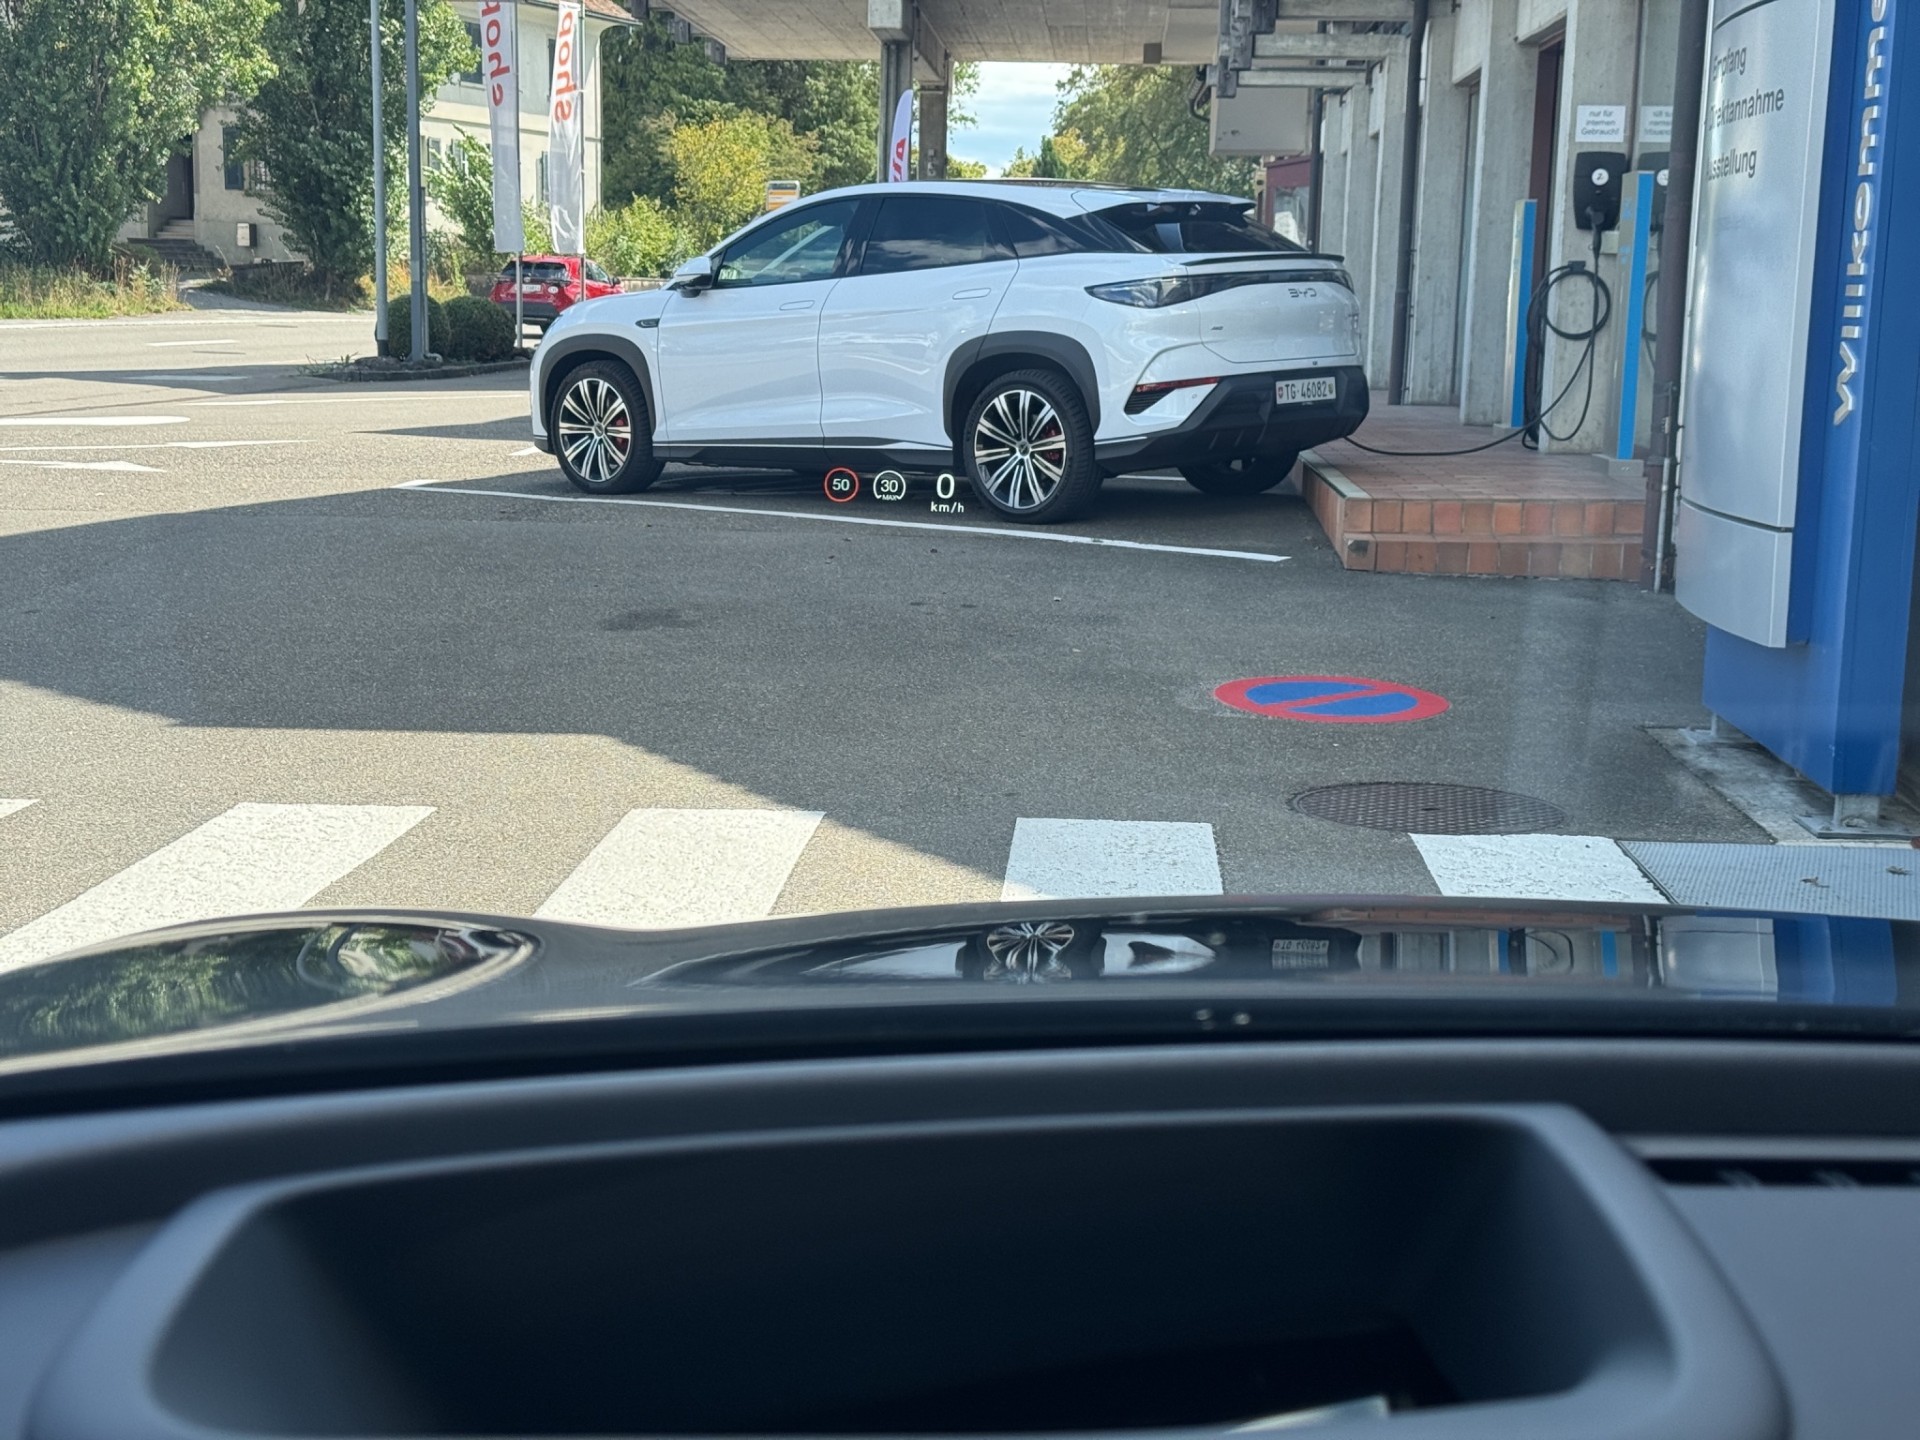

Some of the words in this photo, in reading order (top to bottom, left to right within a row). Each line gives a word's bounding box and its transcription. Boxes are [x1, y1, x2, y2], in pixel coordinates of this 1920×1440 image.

[1708, 88, 1785, 132] Dektannahme
[1706, 148, 1758, 181] sstellung
[1288, 287, 1317, 298] BYD
[832, 478, 850, 492] 50
[880, 479, 898, 493] 30
[936, 473, 955, 500] 0
[930, 501, 965, 513] km/h
